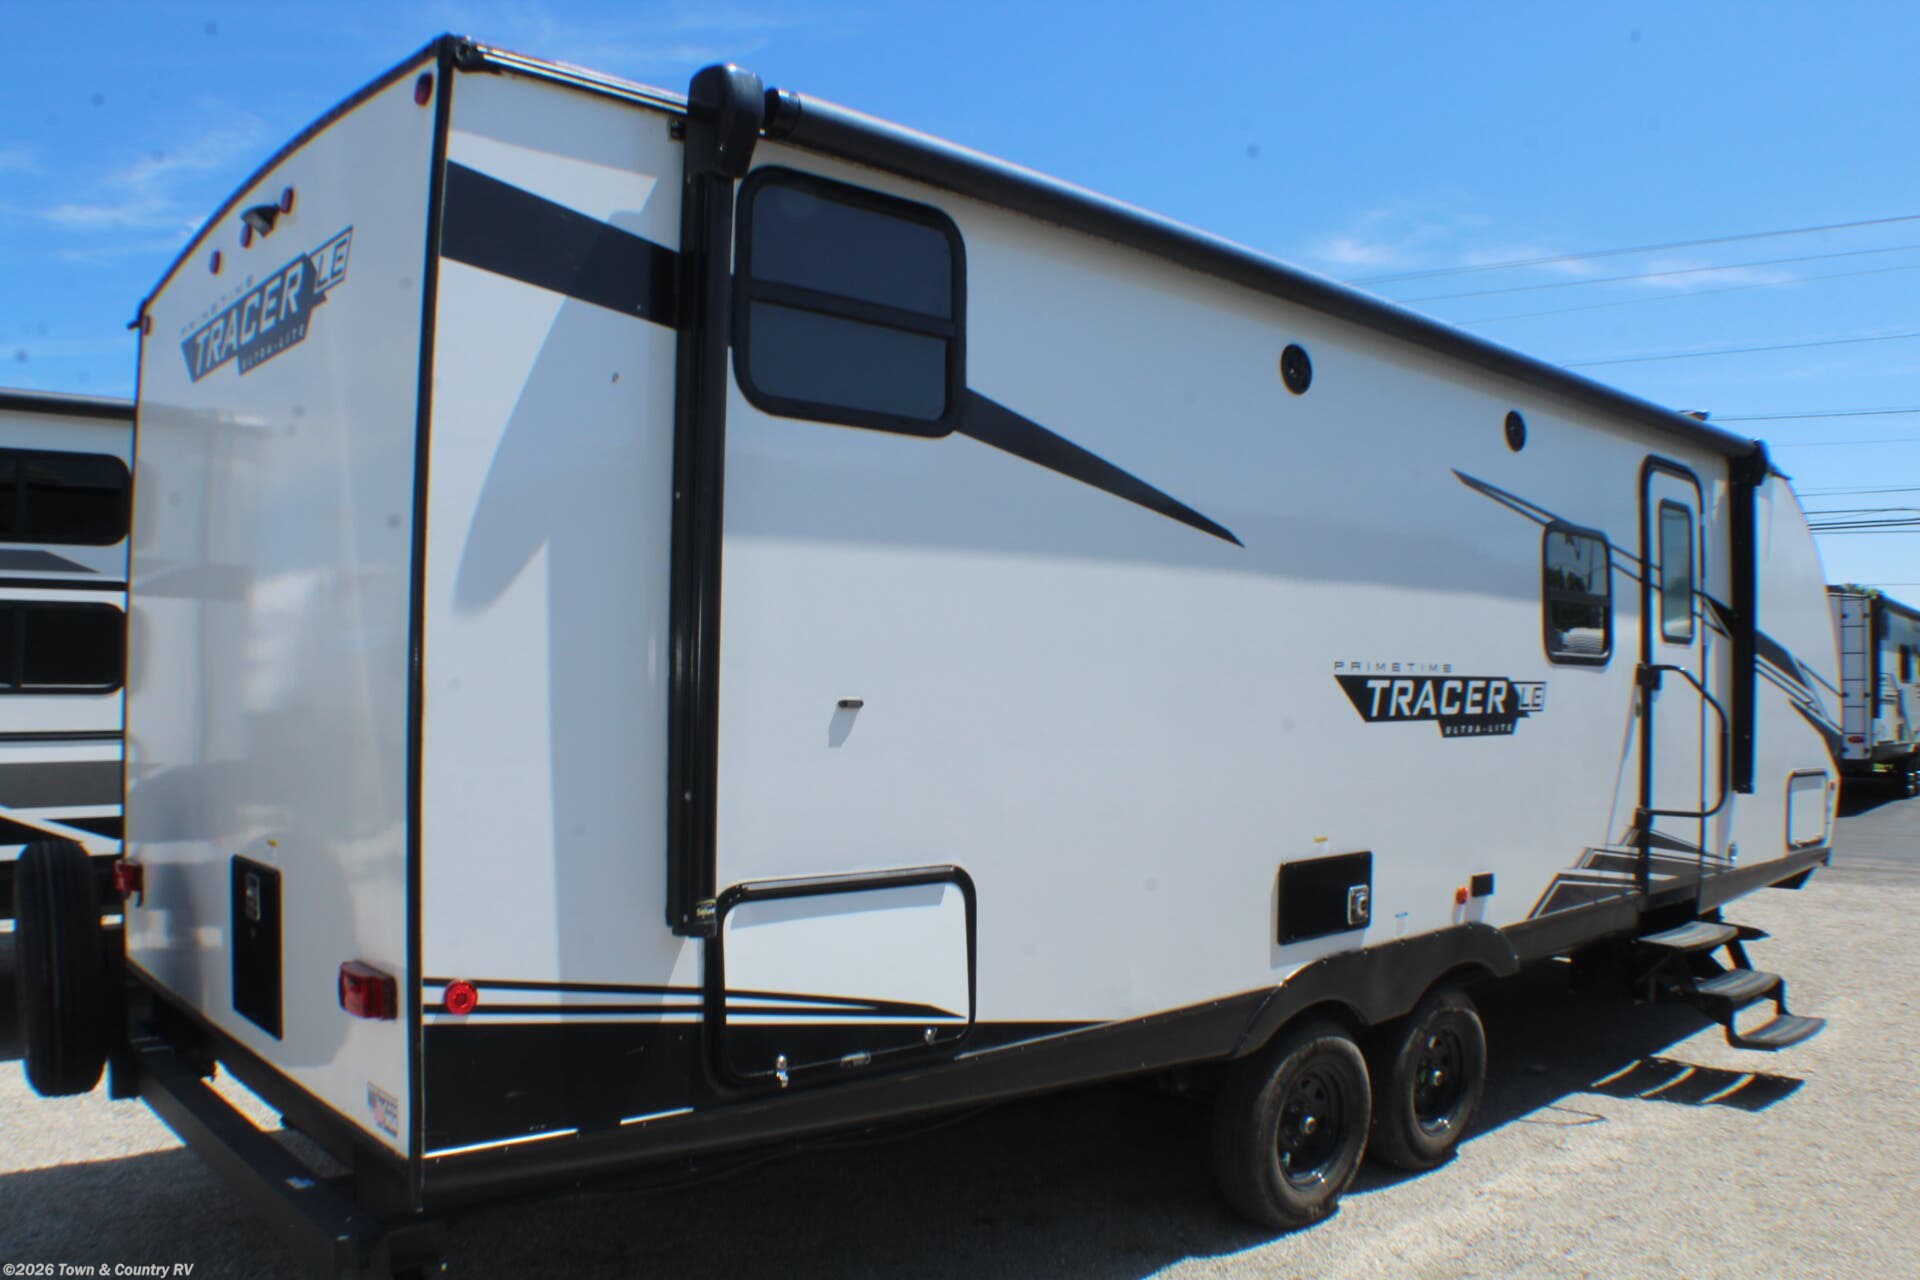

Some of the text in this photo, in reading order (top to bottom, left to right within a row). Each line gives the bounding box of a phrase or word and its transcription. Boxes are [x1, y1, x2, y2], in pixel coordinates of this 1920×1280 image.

[195, 260, 305, 375] TRACER
[317, 236, 348, 287] LE
[1333, 661, 1452, 673] PRIMETIME
[1366, 679, 1544, 718] TRACER LE
